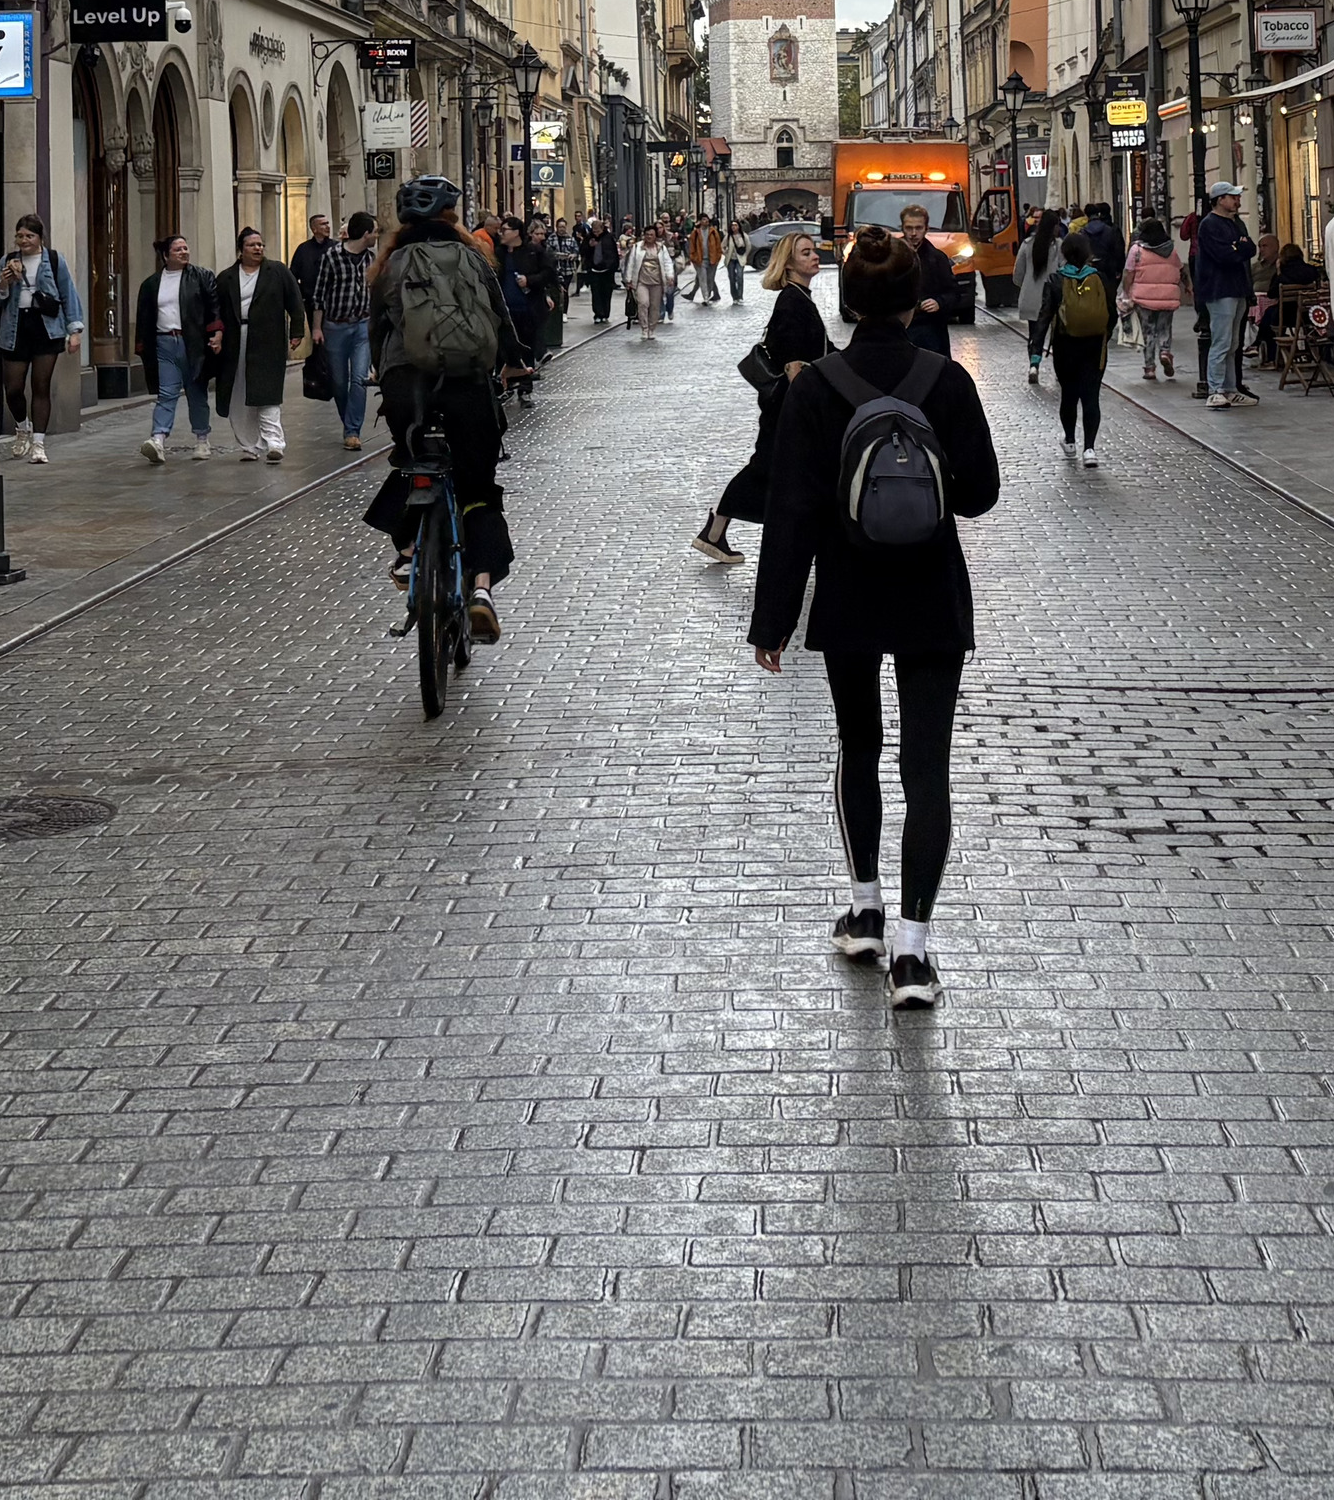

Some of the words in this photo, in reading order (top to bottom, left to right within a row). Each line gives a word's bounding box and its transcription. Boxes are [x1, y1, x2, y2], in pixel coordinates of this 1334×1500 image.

[73, 7, 127, 25] Level
[132, 7, 160, 27] Up
[1263, 21, 1309, 31] Tobacco
[1264, 33, 1309, 44] Cigarettes
[1111, 103, 1142, 111] MONETY
[1112, 130, 1145, 138] BARBER
[1112, 137, 1146, 148] SHOP
